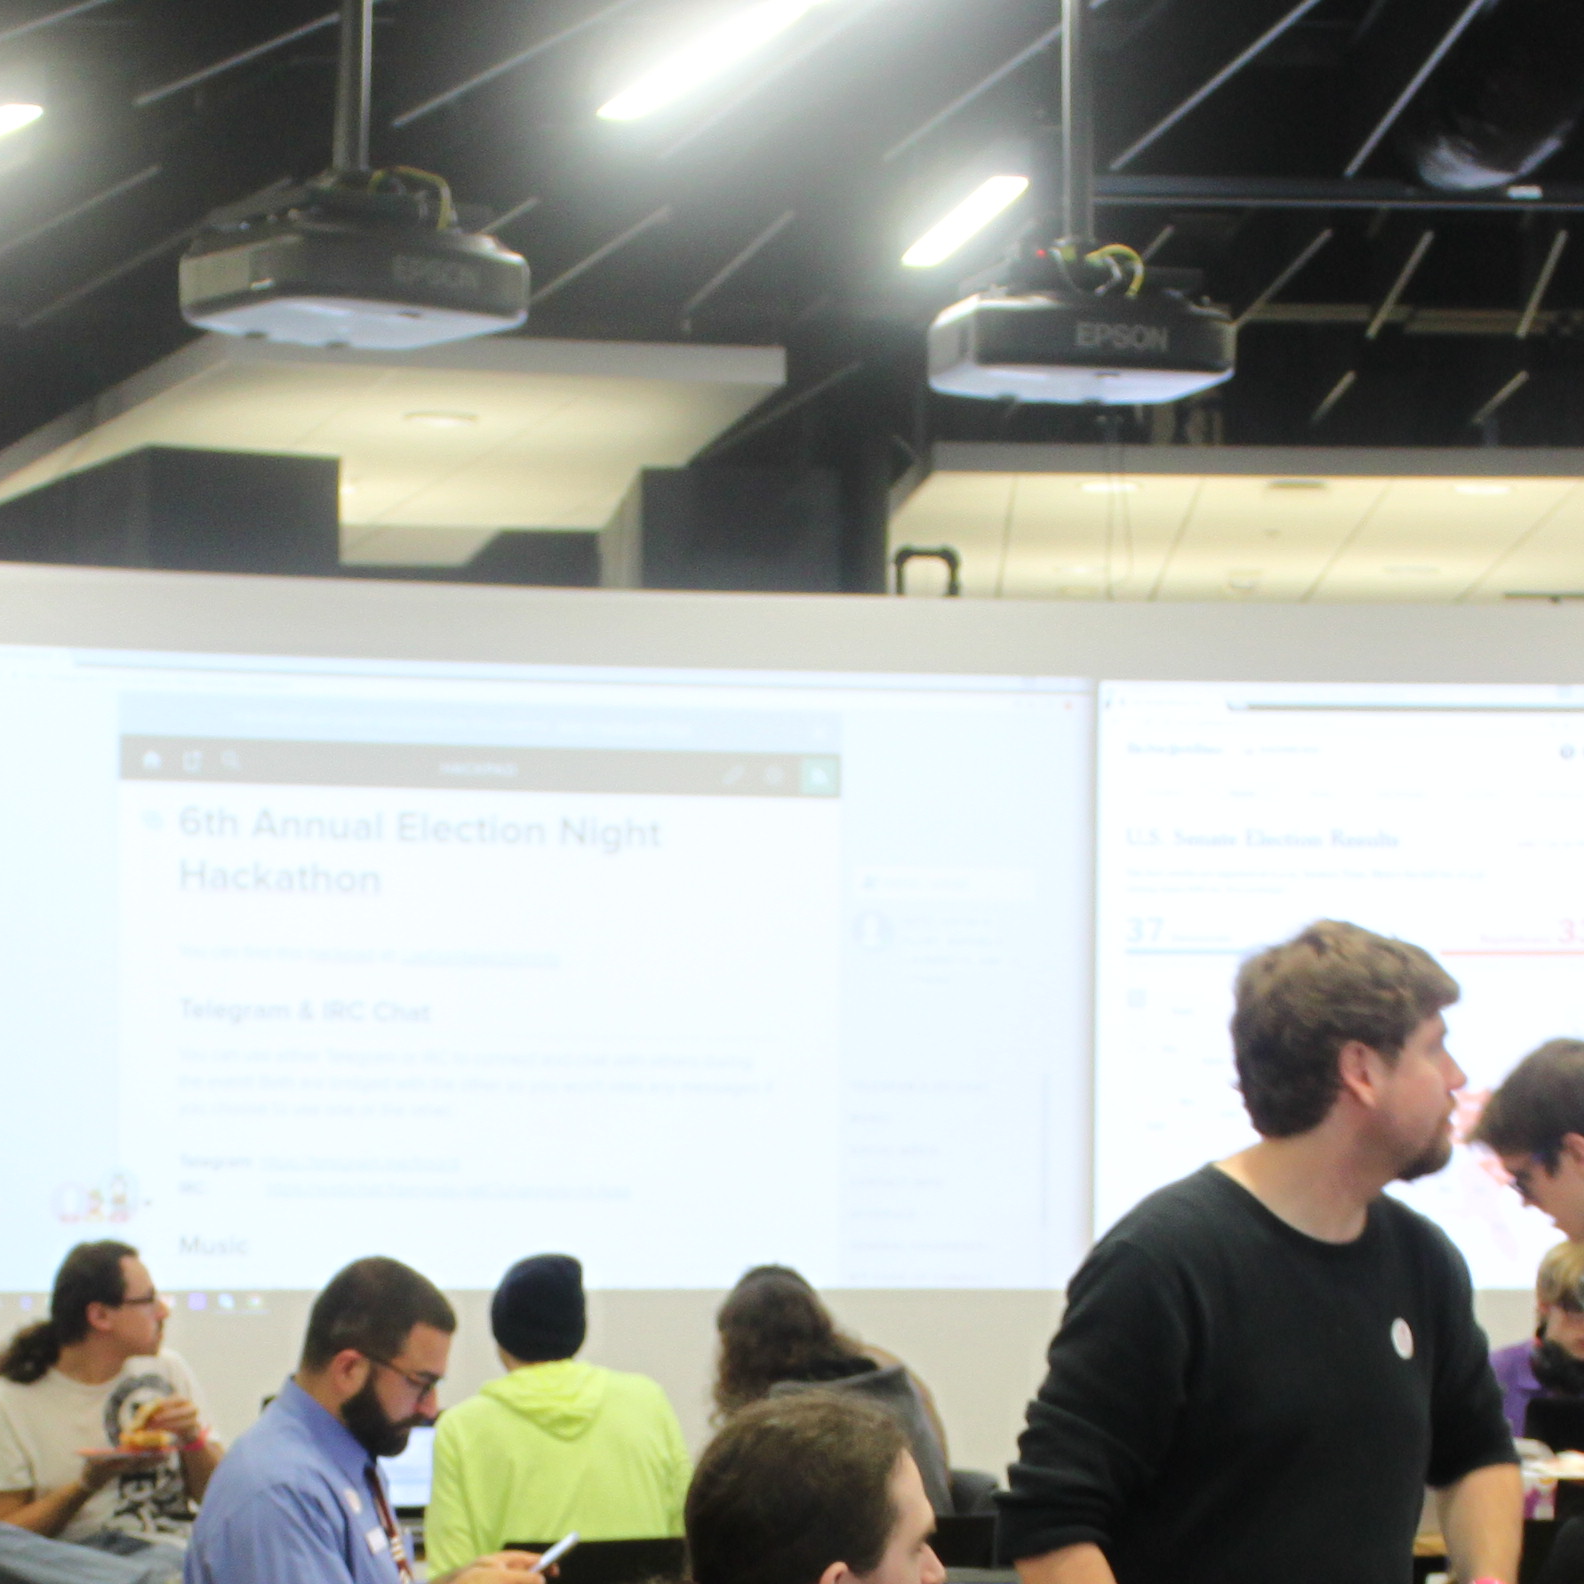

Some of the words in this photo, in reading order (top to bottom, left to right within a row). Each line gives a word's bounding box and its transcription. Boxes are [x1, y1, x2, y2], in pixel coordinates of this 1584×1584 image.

[1076, 322, 1168, 350] EPSON
[178, 805, 239, 839] 6th
[251, 807, 384, 842] Annual
[397, 810, 548, 846] Election
[560, 815, 663, 854] Night
[179, 858, 381, 893] Hackathon
[1126, 915, 1165, 946] 37
[179, 998, 291, 1024] Telegram
[322, 1000, 365, 1022] IRC
[372, 1001, 431, 1024] Chat
[179, 1236, 250, 1255] Music
